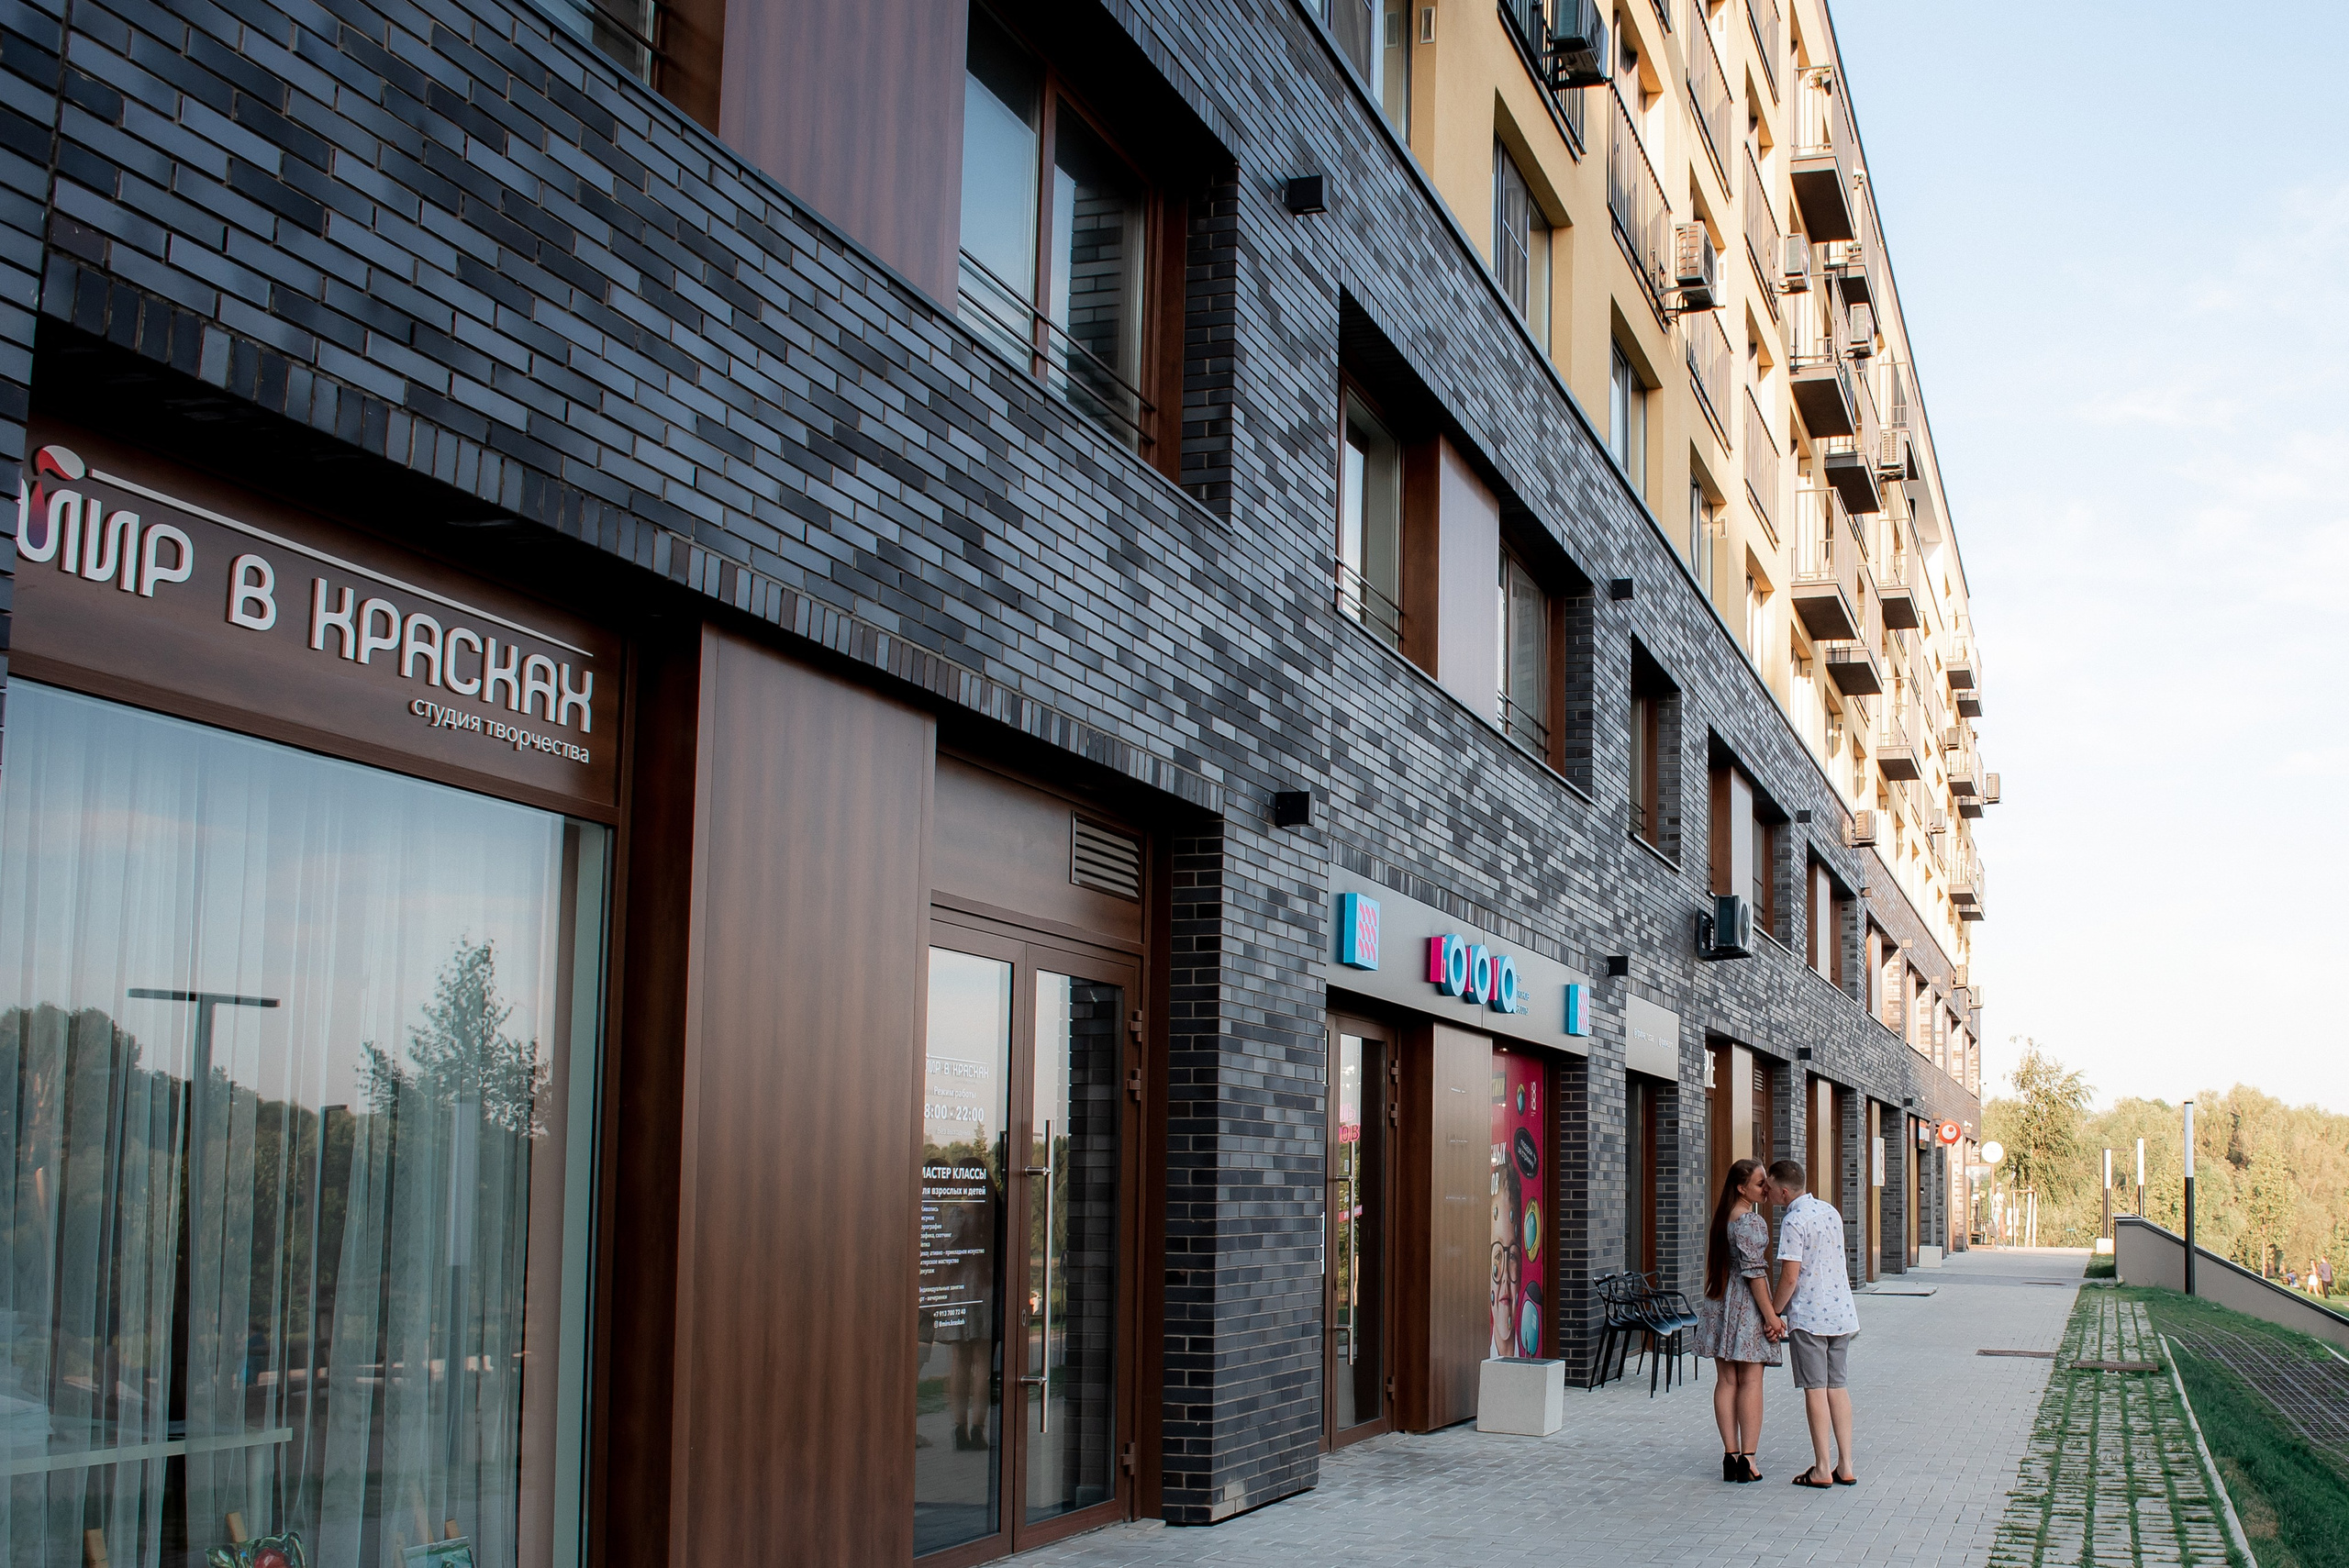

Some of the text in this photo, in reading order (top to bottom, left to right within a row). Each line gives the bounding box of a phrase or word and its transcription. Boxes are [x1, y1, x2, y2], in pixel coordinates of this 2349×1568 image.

[17, 476, 594, 733] МИР В КРАСКАХ
[412, 698, 590, 763] студия творчества
[943, 1062, 950, 1074] В
[952, 1063, 989, 1079] КРАСКАХ
[933, 1085, 976, 1099] Режим работы
[955, 1106, 985, 1122] 22:00
[952, 1167, 987, 1180] КЛАССЫ
[931, 1187, 963, 1198] взрослых
[968, 1185, 986, 1196] детей
